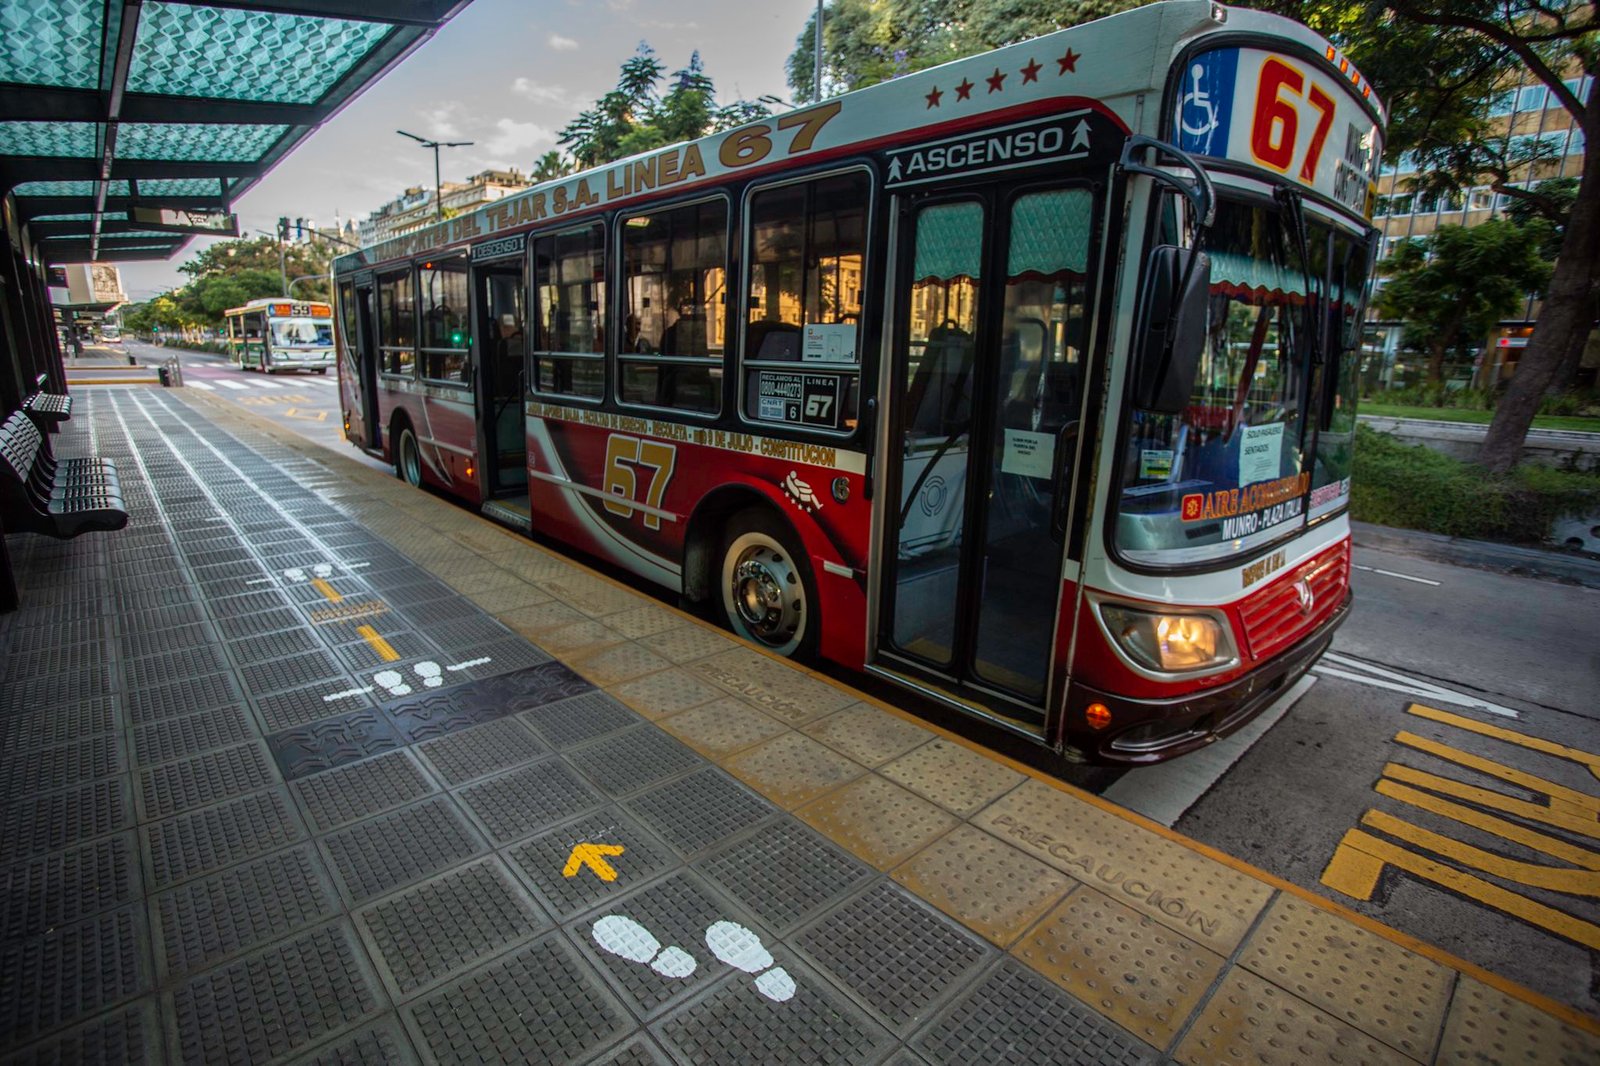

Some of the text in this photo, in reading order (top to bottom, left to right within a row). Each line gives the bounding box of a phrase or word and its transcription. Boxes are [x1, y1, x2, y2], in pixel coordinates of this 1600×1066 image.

[1250, 55, 1337, 186] 67
[906, 127, 1063, 175] ASCENSO
[452, 216, 481, 242] DEL
[486, 192, 547, 232] TEJAR
[553, 179, 599, 215] S.A.
[607, 143, 706, 200] LINEA
[719, 101, 842, 168] 67
[478, 237, 518, 257] DESCENSO
[292, 305, 310, 315] 59
[761, 374, 792, 383] RECLAMOS
[806, 378, 834, 387] LINEA
[761, 398, 783, 407] CNRT
[789, 406, 797, 419] 6
[805, 394, 834, 418] 67
[652, 419, 688, 442] RECOLETA
[714, 430, 726, 448] DE
[727, 433, 753, 453] JULIO
[760, 438, 836, 468] CONSTITUCION
[603, 433, 677, 531] 67
[1201, 489, 1239, 519] AIRE
[1222, 513, 1258, 541] MUNRO
[1262, 504, 1284, 528] PLAZA
